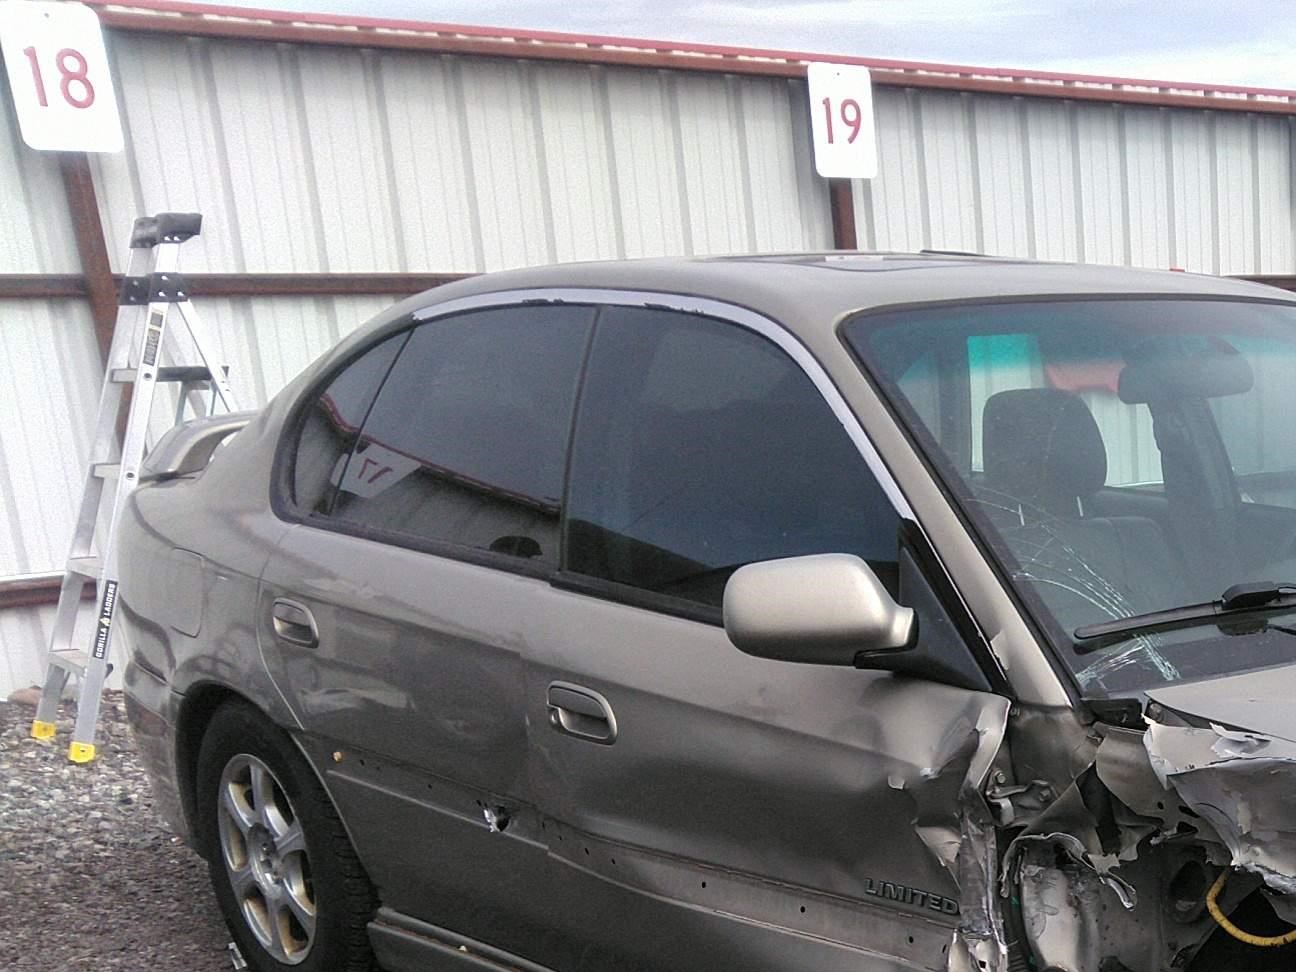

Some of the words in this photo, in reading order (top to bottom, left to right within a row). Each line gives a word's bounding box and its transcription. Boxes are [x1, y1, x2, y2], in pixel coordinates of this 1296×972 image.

[23, 46, 95, 109] 18
[822, 97, 862, 144] 19
[95, 627, 107, 658] GORILLA
[103, 583, 116, 616] LADDERS
[864, 878, 960, 915] LIMITED
